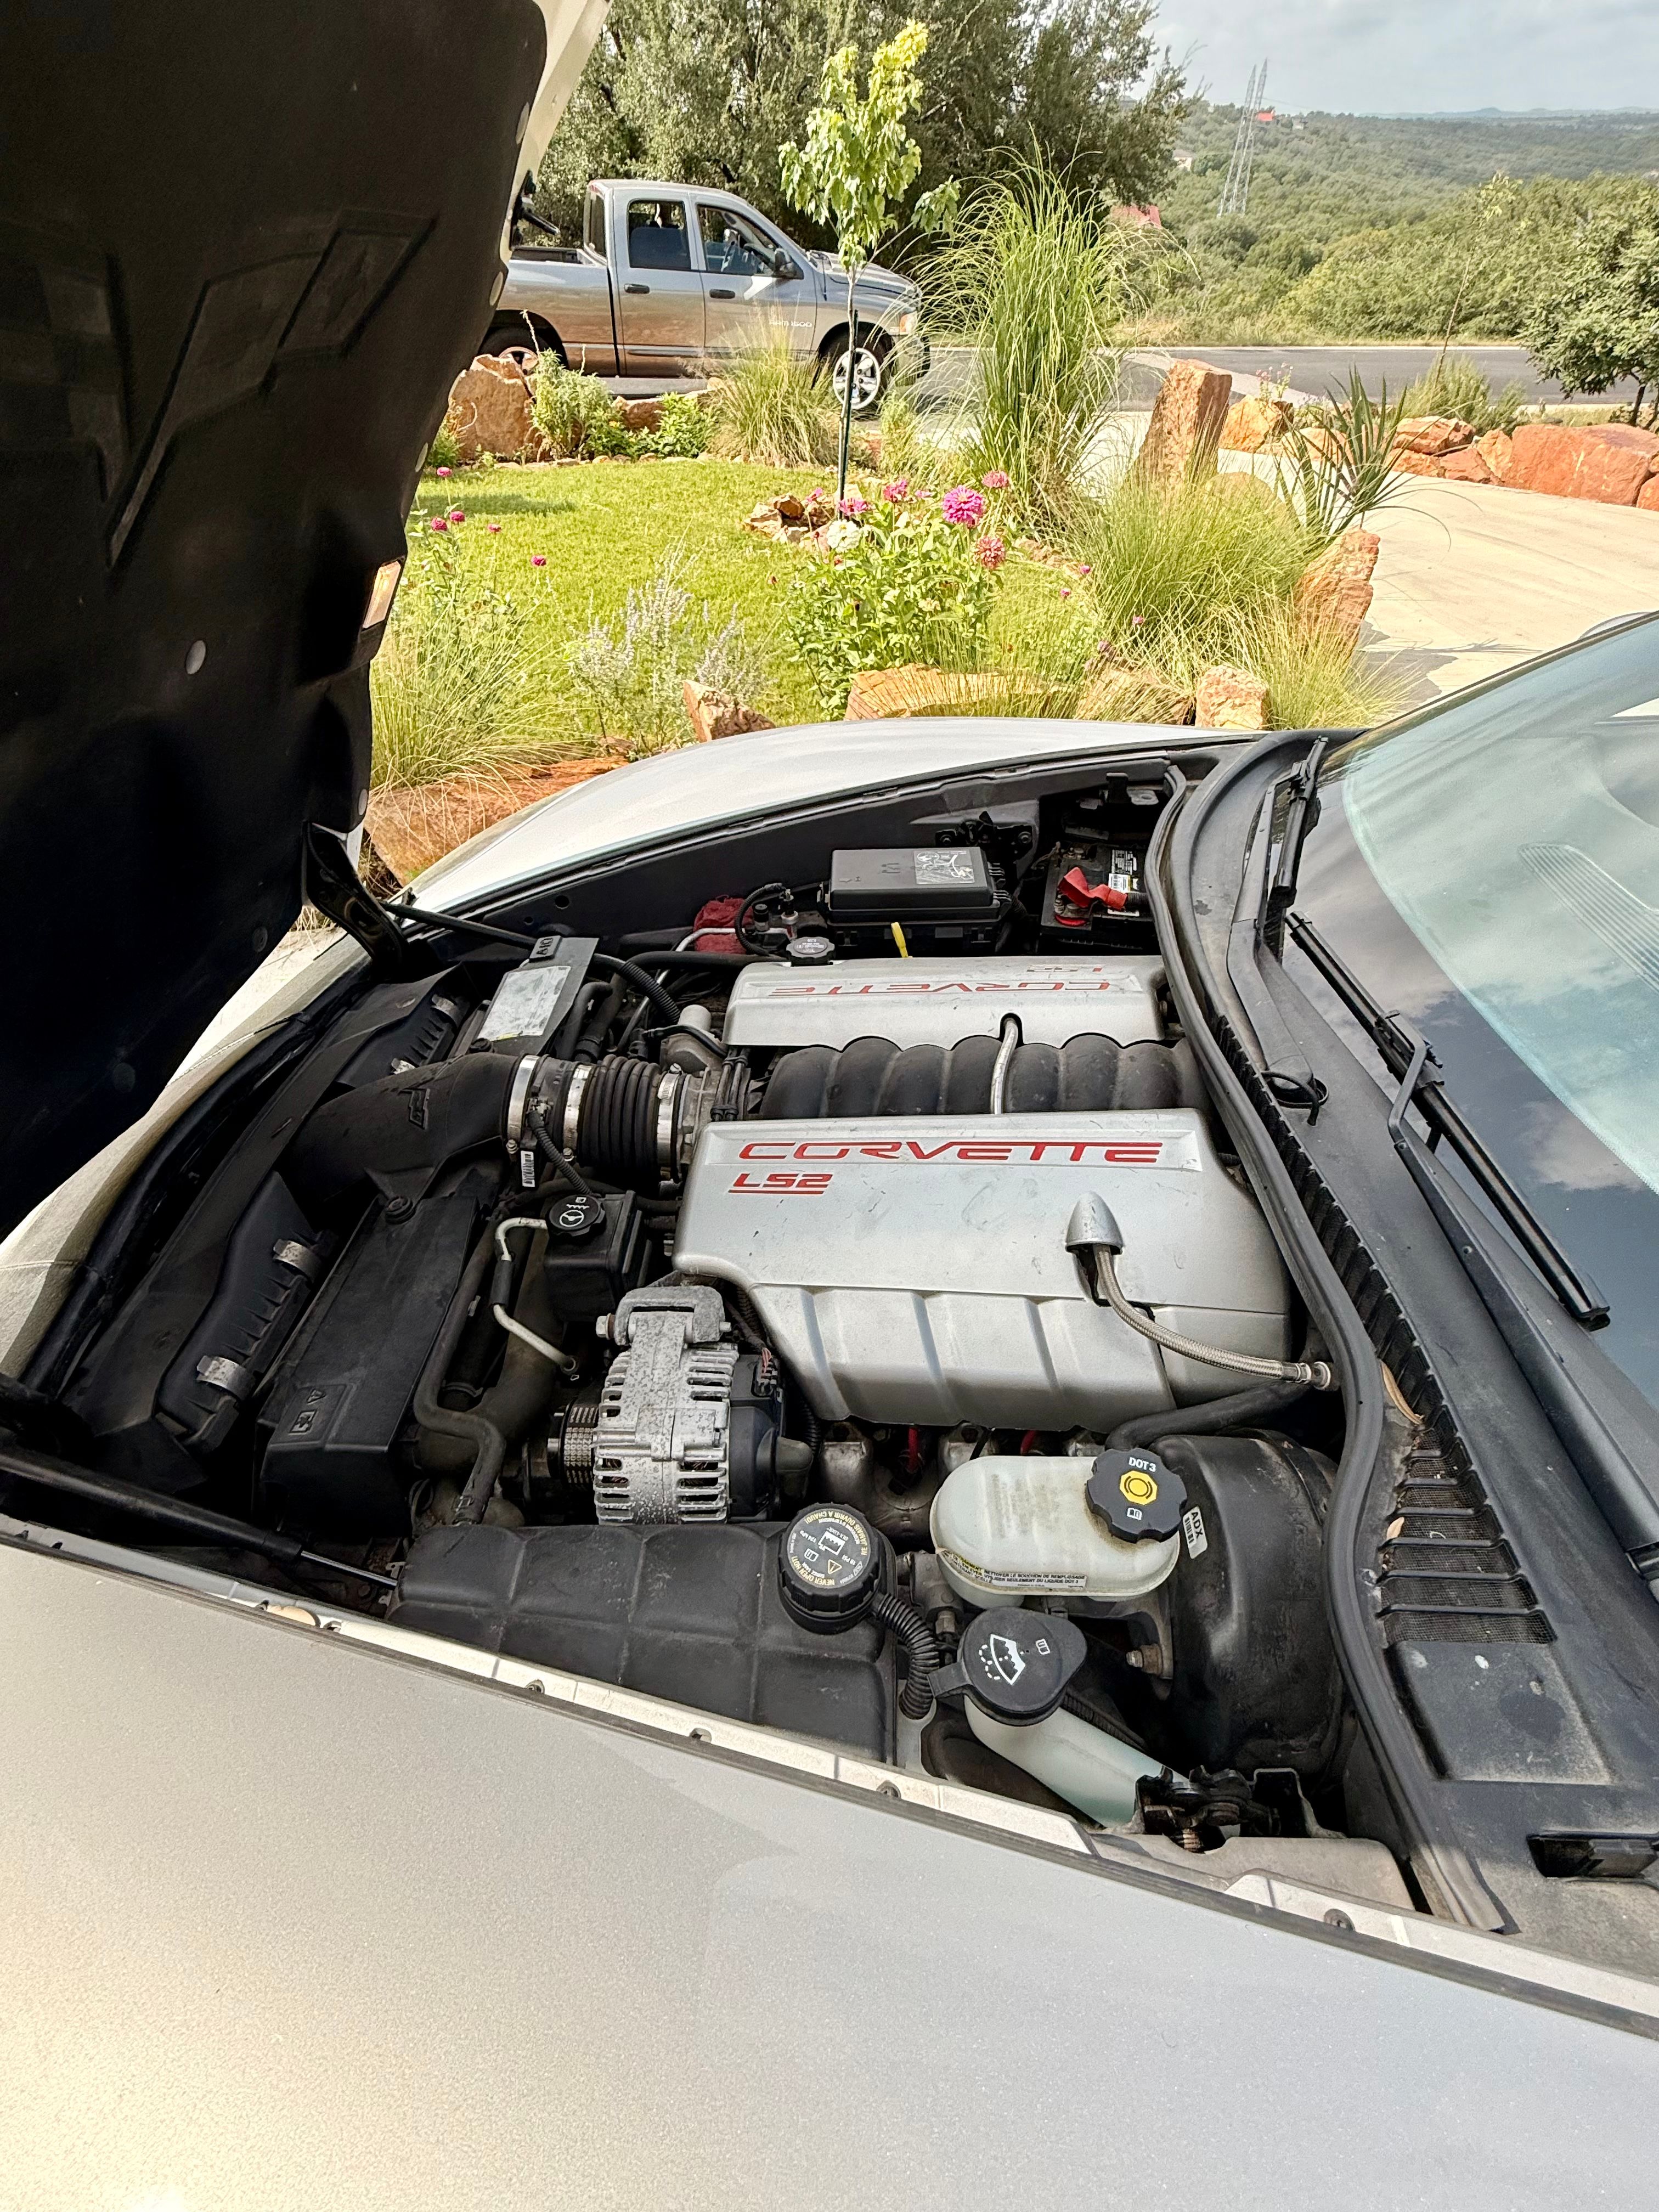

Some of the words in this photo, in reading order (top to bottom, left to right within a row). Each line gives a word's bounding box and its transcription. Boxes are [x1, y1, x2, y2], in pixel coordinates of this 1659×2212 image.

[769, 981, 1110, 996] CORVETTE
[738, 1141, 1163, 1163] CORVETTE
[732, 1172, 833, 1190] LS2
[1128, 1457, 1149, 1470] DOT
[1149, 1463, 1156, 1472] 3
[834, 1511, 855, 1525] OUVRIR
[1191, 1511, 1203, 1539] ADX
[808, 1534, 817, 1543] 124
[854, 1524, 868, 1547] JAMAIS
[791, 1555, 802, 1570] HOT!
[842, 1554, 851, 1562] PSI
[799, 1570, 815, 1582] OPEN
[814, 1577, 835, 1585] NEVER
